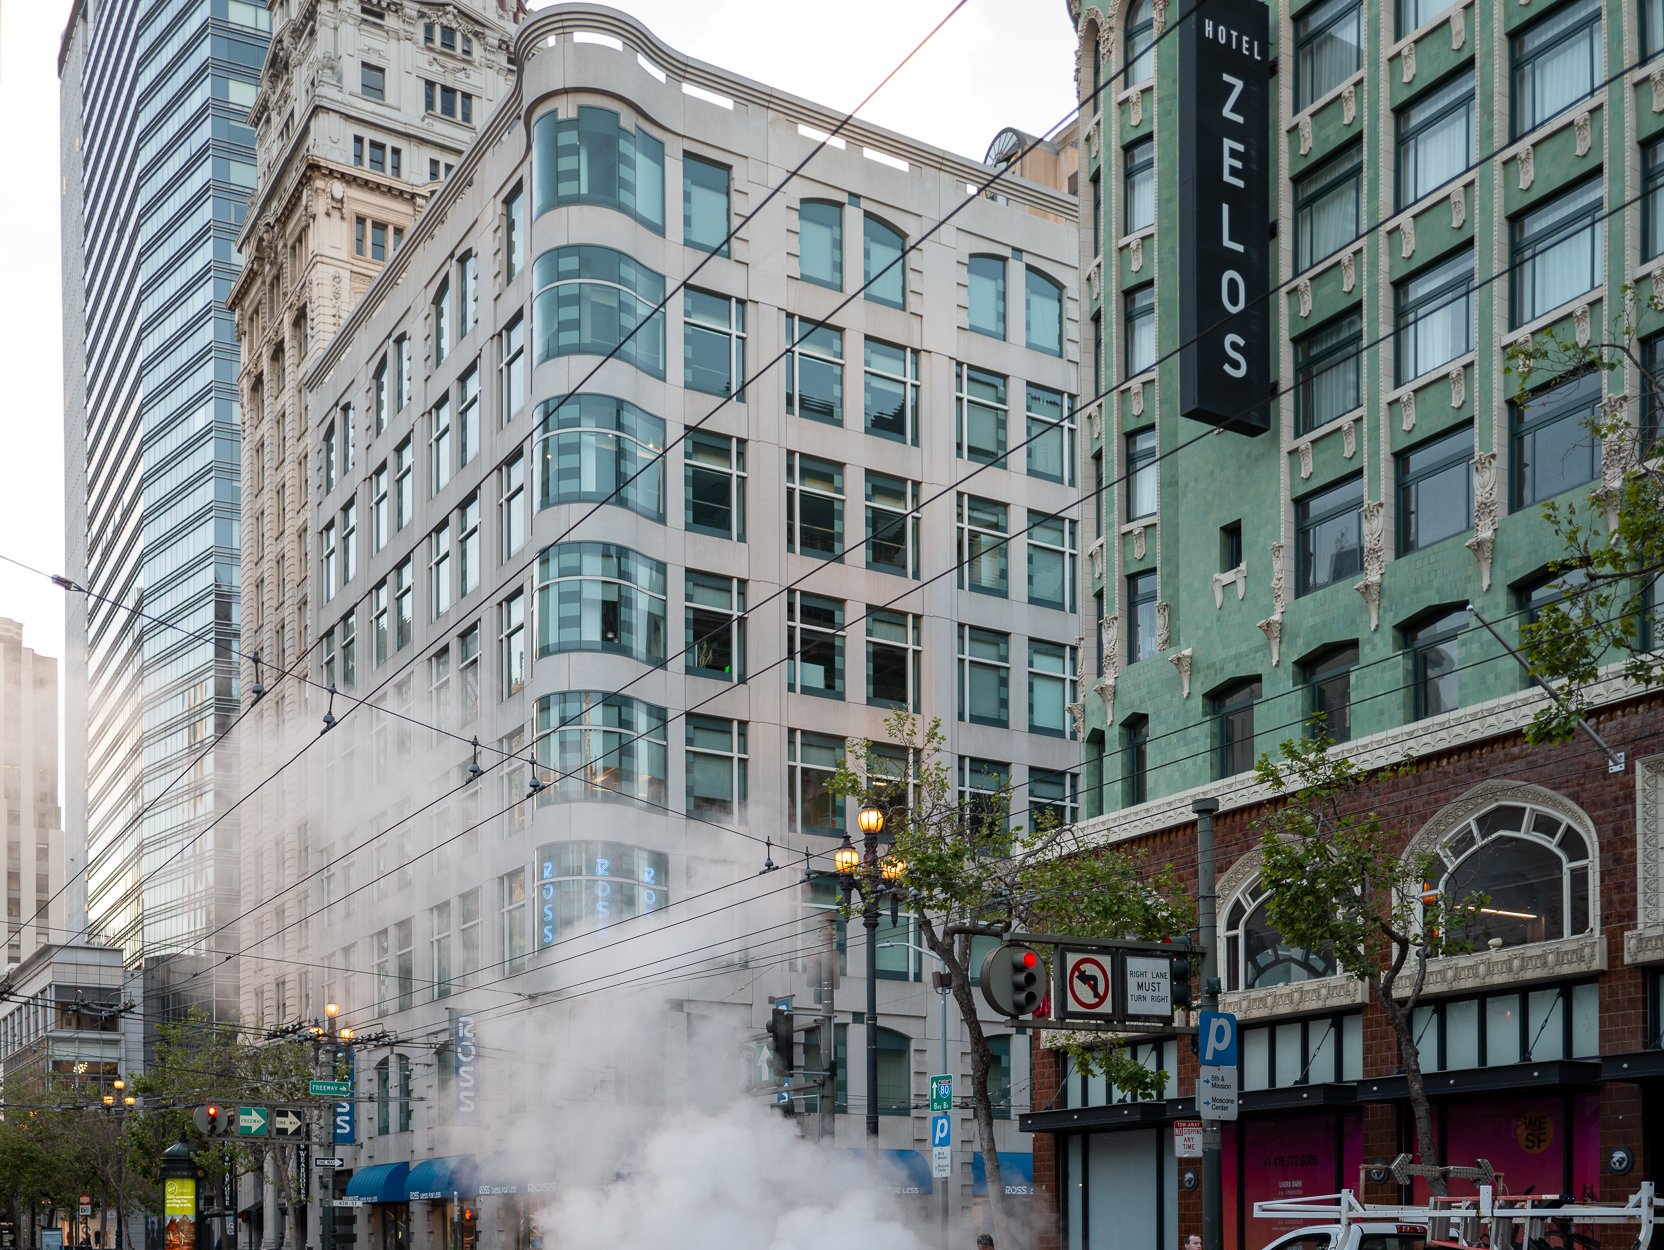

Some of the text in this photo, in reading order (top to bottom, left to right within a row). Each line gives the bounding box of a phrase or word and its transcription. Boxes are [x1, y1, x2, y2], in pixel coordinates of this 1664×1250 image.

[1205, 19, 1261, 60] HOTEL
[1222, 72, 1247, 378] ZELOS
[543, 861, 554, 943] ROSS
[1129, 970, 1168, 980] RIGHT LANE
[1137, 981, 1161, 992] MUST
[1130, 994, 1169, 1003] TURN RIGHT
[457, 1016, 475, 1112] ROSS
[312, 1084, 338, 1092] FREEWAY
[940, 1085, 950, 1095] 80
[1211, 1096, 1234, 1104] Moscone
[527, 1183, 557, 1193] ROSS
[1005, 1186, 1027, 1195] ROSS
